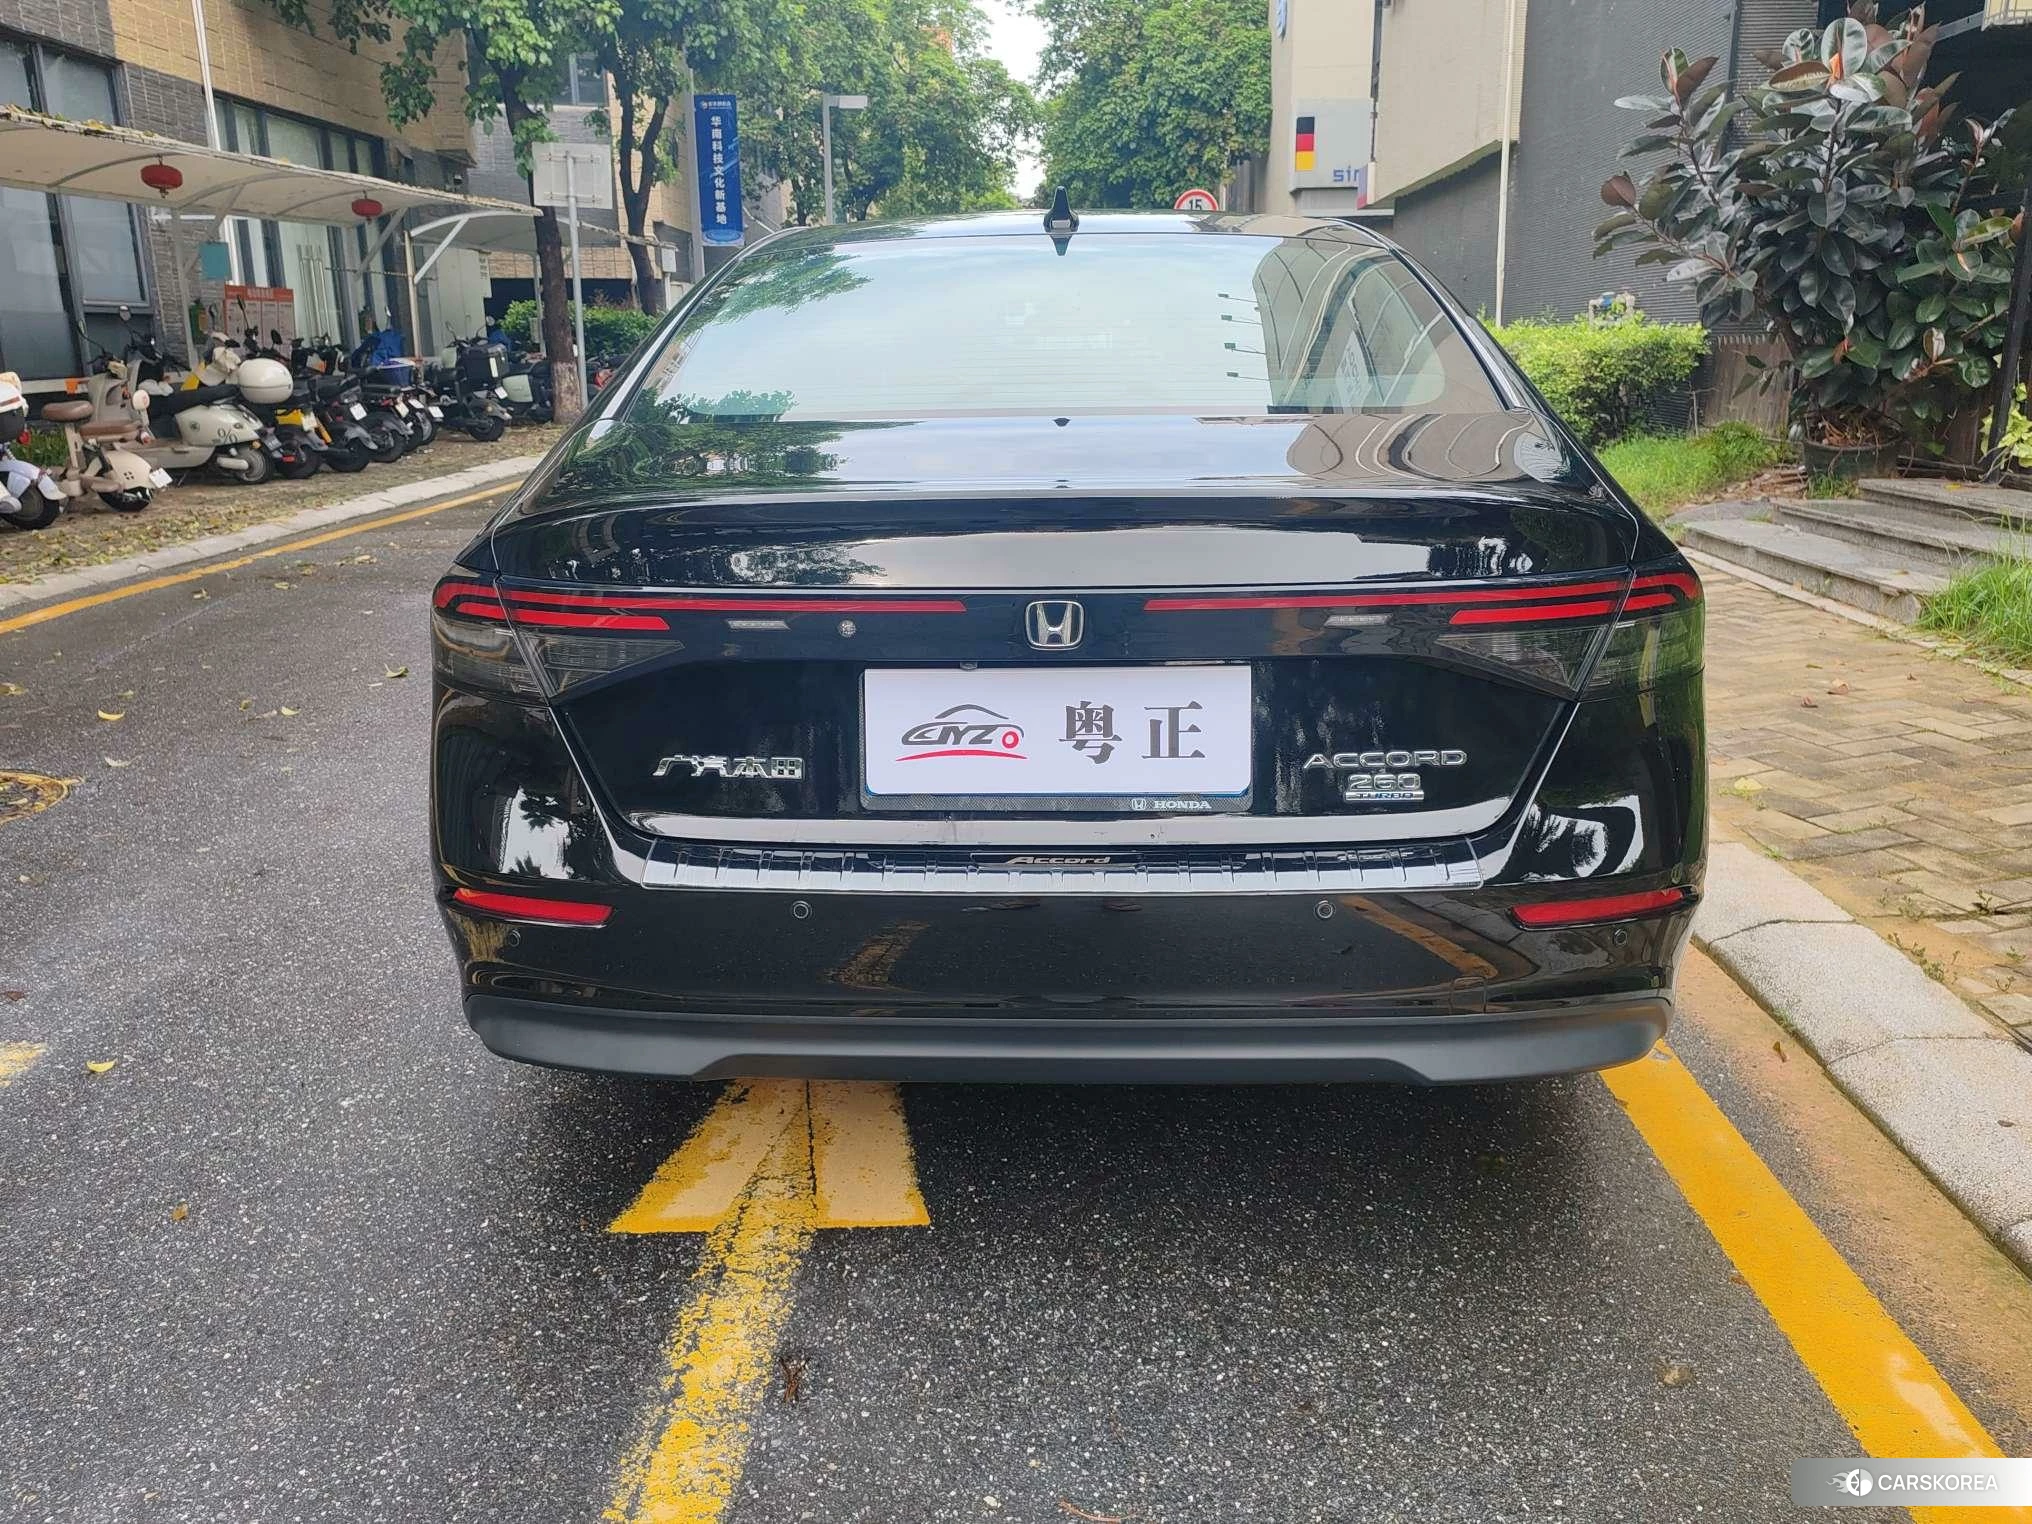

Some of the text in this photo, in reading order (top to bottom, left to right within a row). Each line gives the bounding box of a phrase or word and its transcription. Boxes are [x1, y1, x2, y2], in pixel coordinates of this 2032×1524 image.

[711, 116, 727, 225] 华南科技文化新基地
[1189, 199, 1202, 210] 15
[1058, 700, 1206, 765] 粤正
[652, 754, 805, 779] 广汽本田
[1303, 750, 1468, 769] ACCORD
[1349, 773, 1421, 790] 260
[1154, 800, 1212, 809] HONDA
[1005, 856, 1111, 865] Accord
